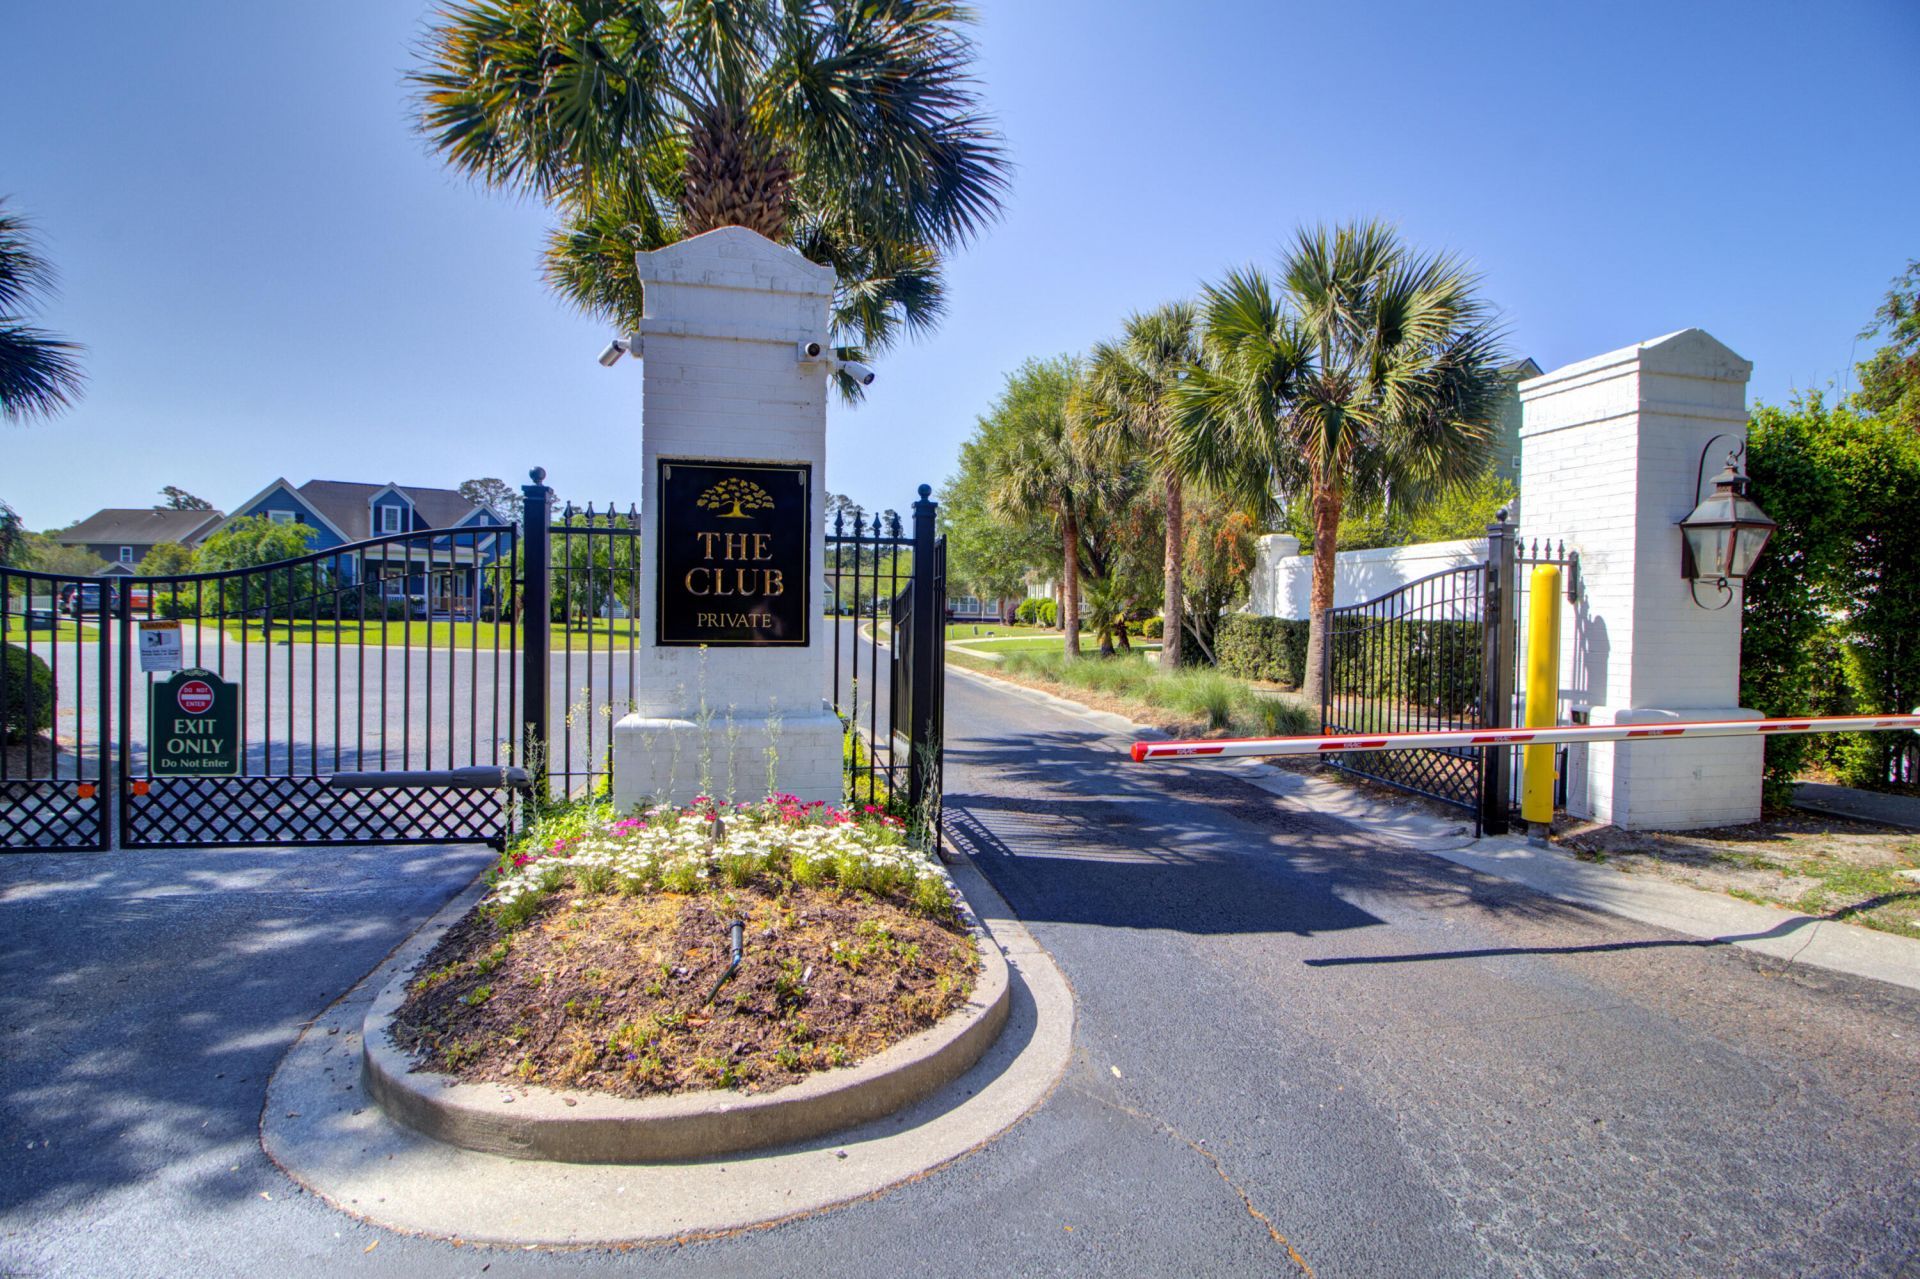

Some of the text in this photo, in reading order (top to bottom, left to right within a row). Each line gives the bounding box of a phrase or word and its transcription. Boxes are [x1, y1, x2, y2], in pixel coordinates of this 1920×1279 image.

[697, 531, 773, 561] THE
[685, 567, 784, 596] CLUB
[697, 613, 772, 628] PRIVATE
[174, 719, 216, 734] EXIT
[166, 738, 224, 754] ONLY
[161, 759, 229, 768] Do Not Enter
